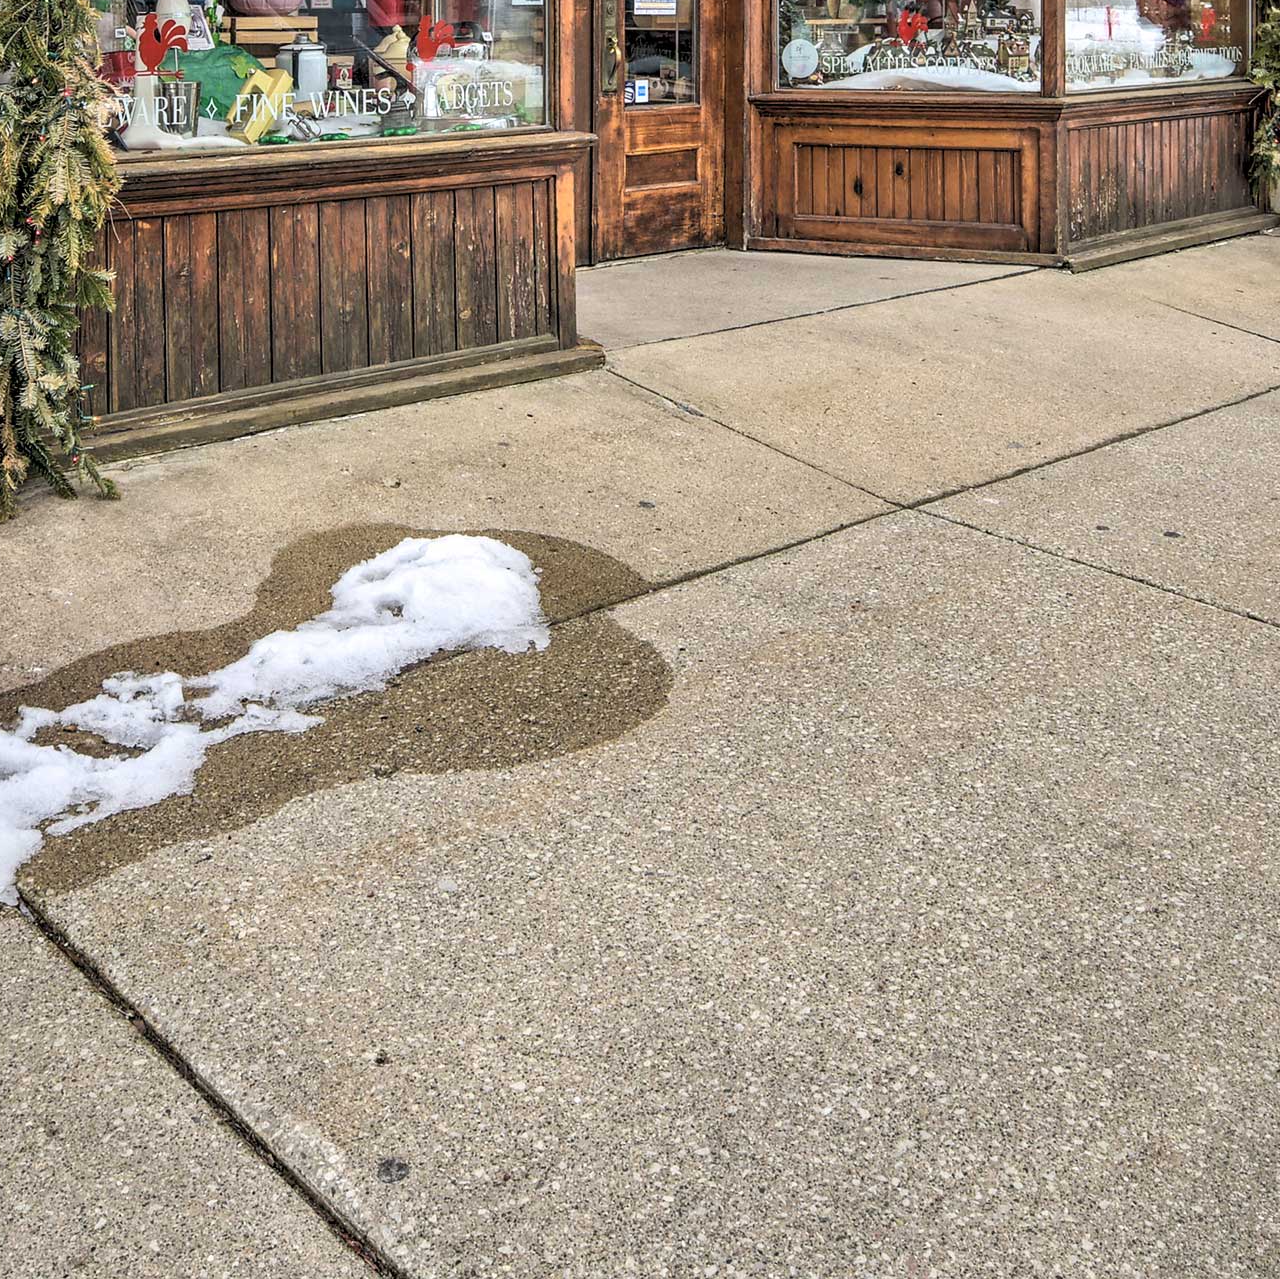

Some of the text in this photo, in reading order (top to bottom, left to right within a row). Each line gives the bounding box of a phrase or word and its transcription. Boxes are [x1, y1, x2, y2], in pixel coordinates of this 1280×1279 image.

[822, 55, 919, 74] SPECIALTIES
[1130, 50, 1169, 70] PASTRIES
[235, 92, 297, 122] FINE
[310, 87, 392, 118] WINES
[430, 81, 513, 111] ADGETS
